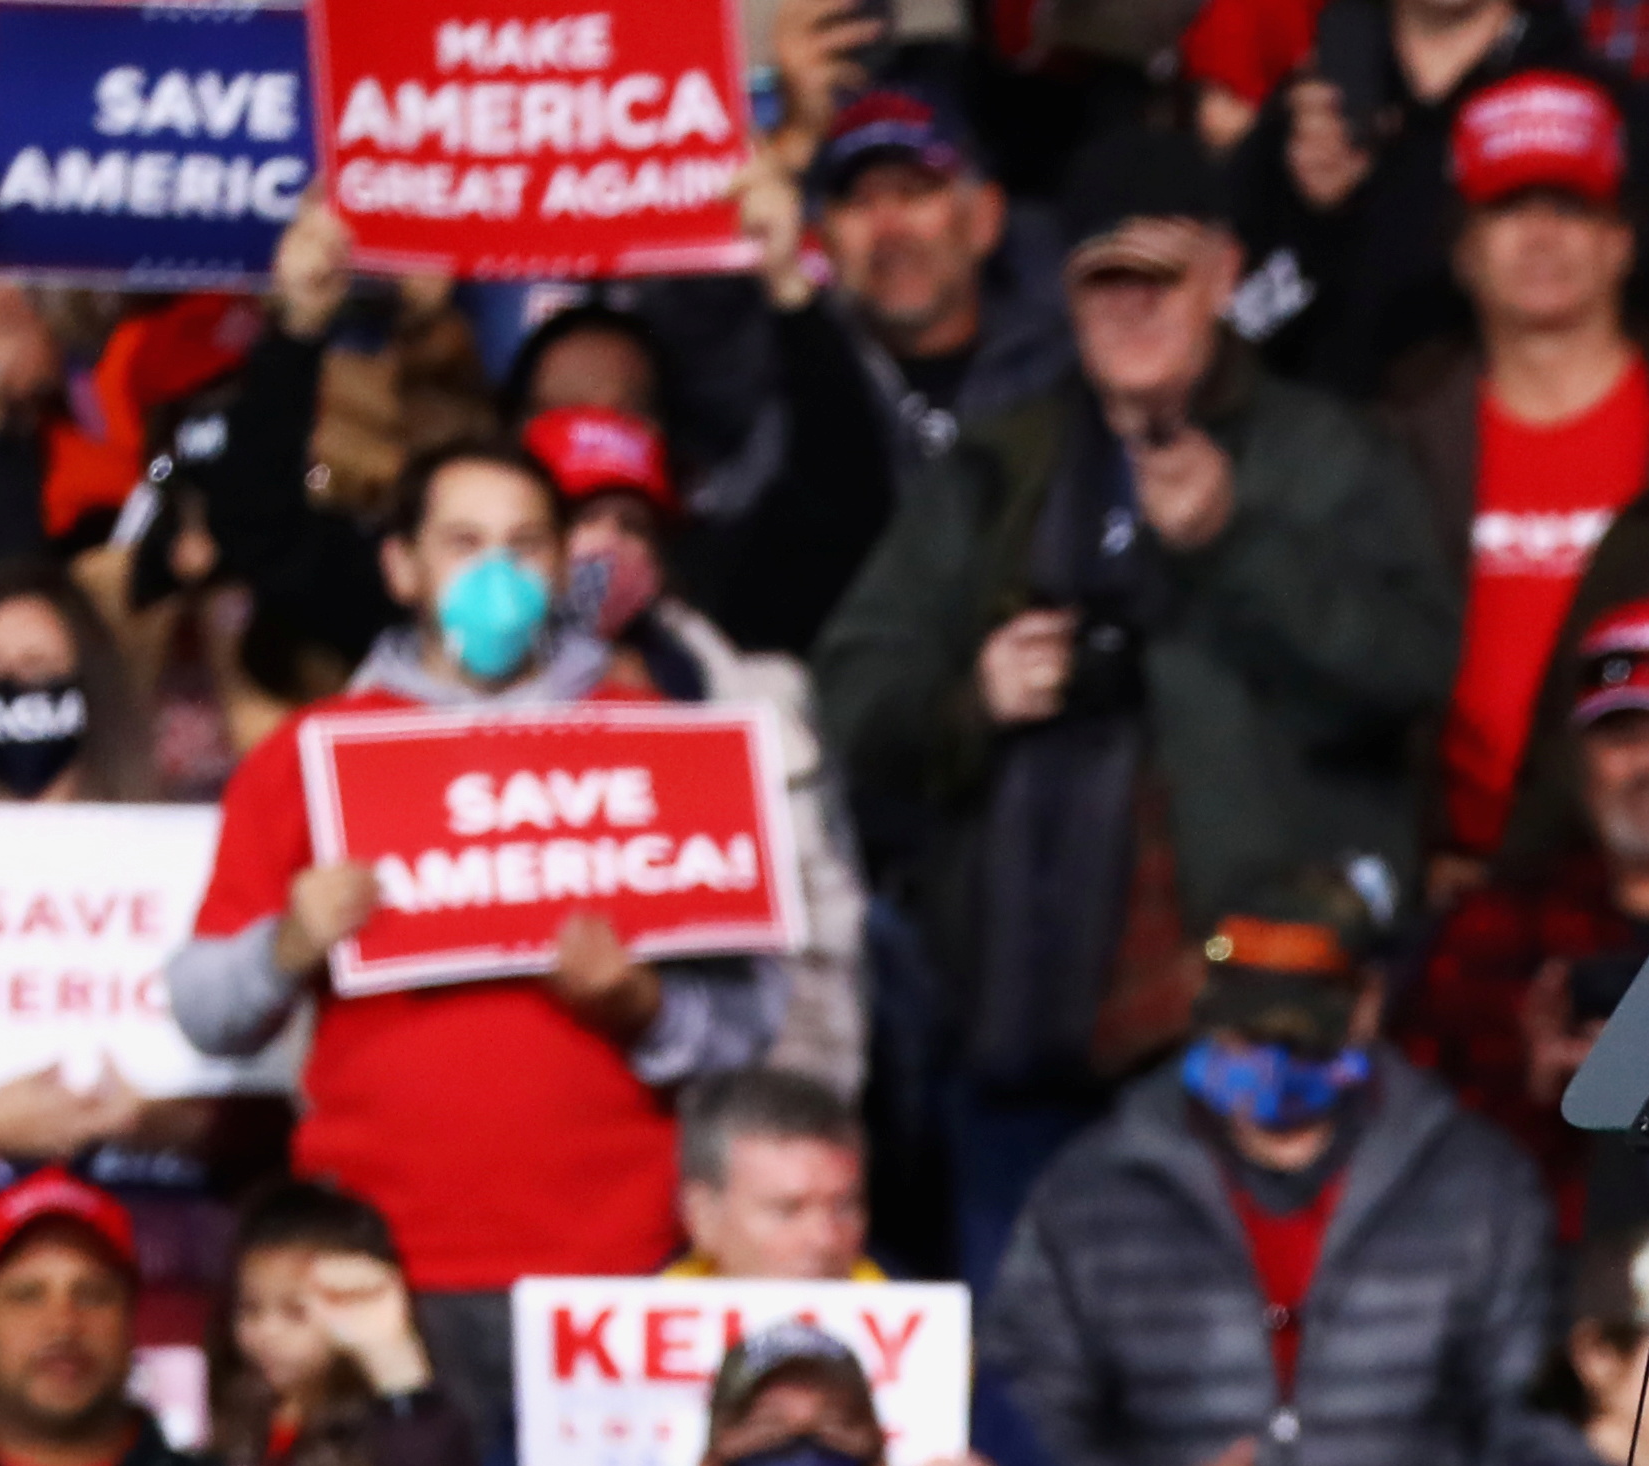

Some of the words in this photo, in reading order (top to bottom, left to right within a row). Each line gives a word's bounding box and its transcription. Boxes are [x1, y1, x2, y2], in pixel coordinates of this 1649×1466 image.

[436, 14, 611, 73] MAKE
[94, 65, 300, 139] SAVE
[337, 69, 729, 155] AMERICA
[338, 156, 531, 219] GREAT
[541, 158, 736, 219] AGAIN
[444, 766, 658, 835] SAVE
[373, 831, 760, 916] AMERICA!
[551, 1306, 926, 1384] KEY
